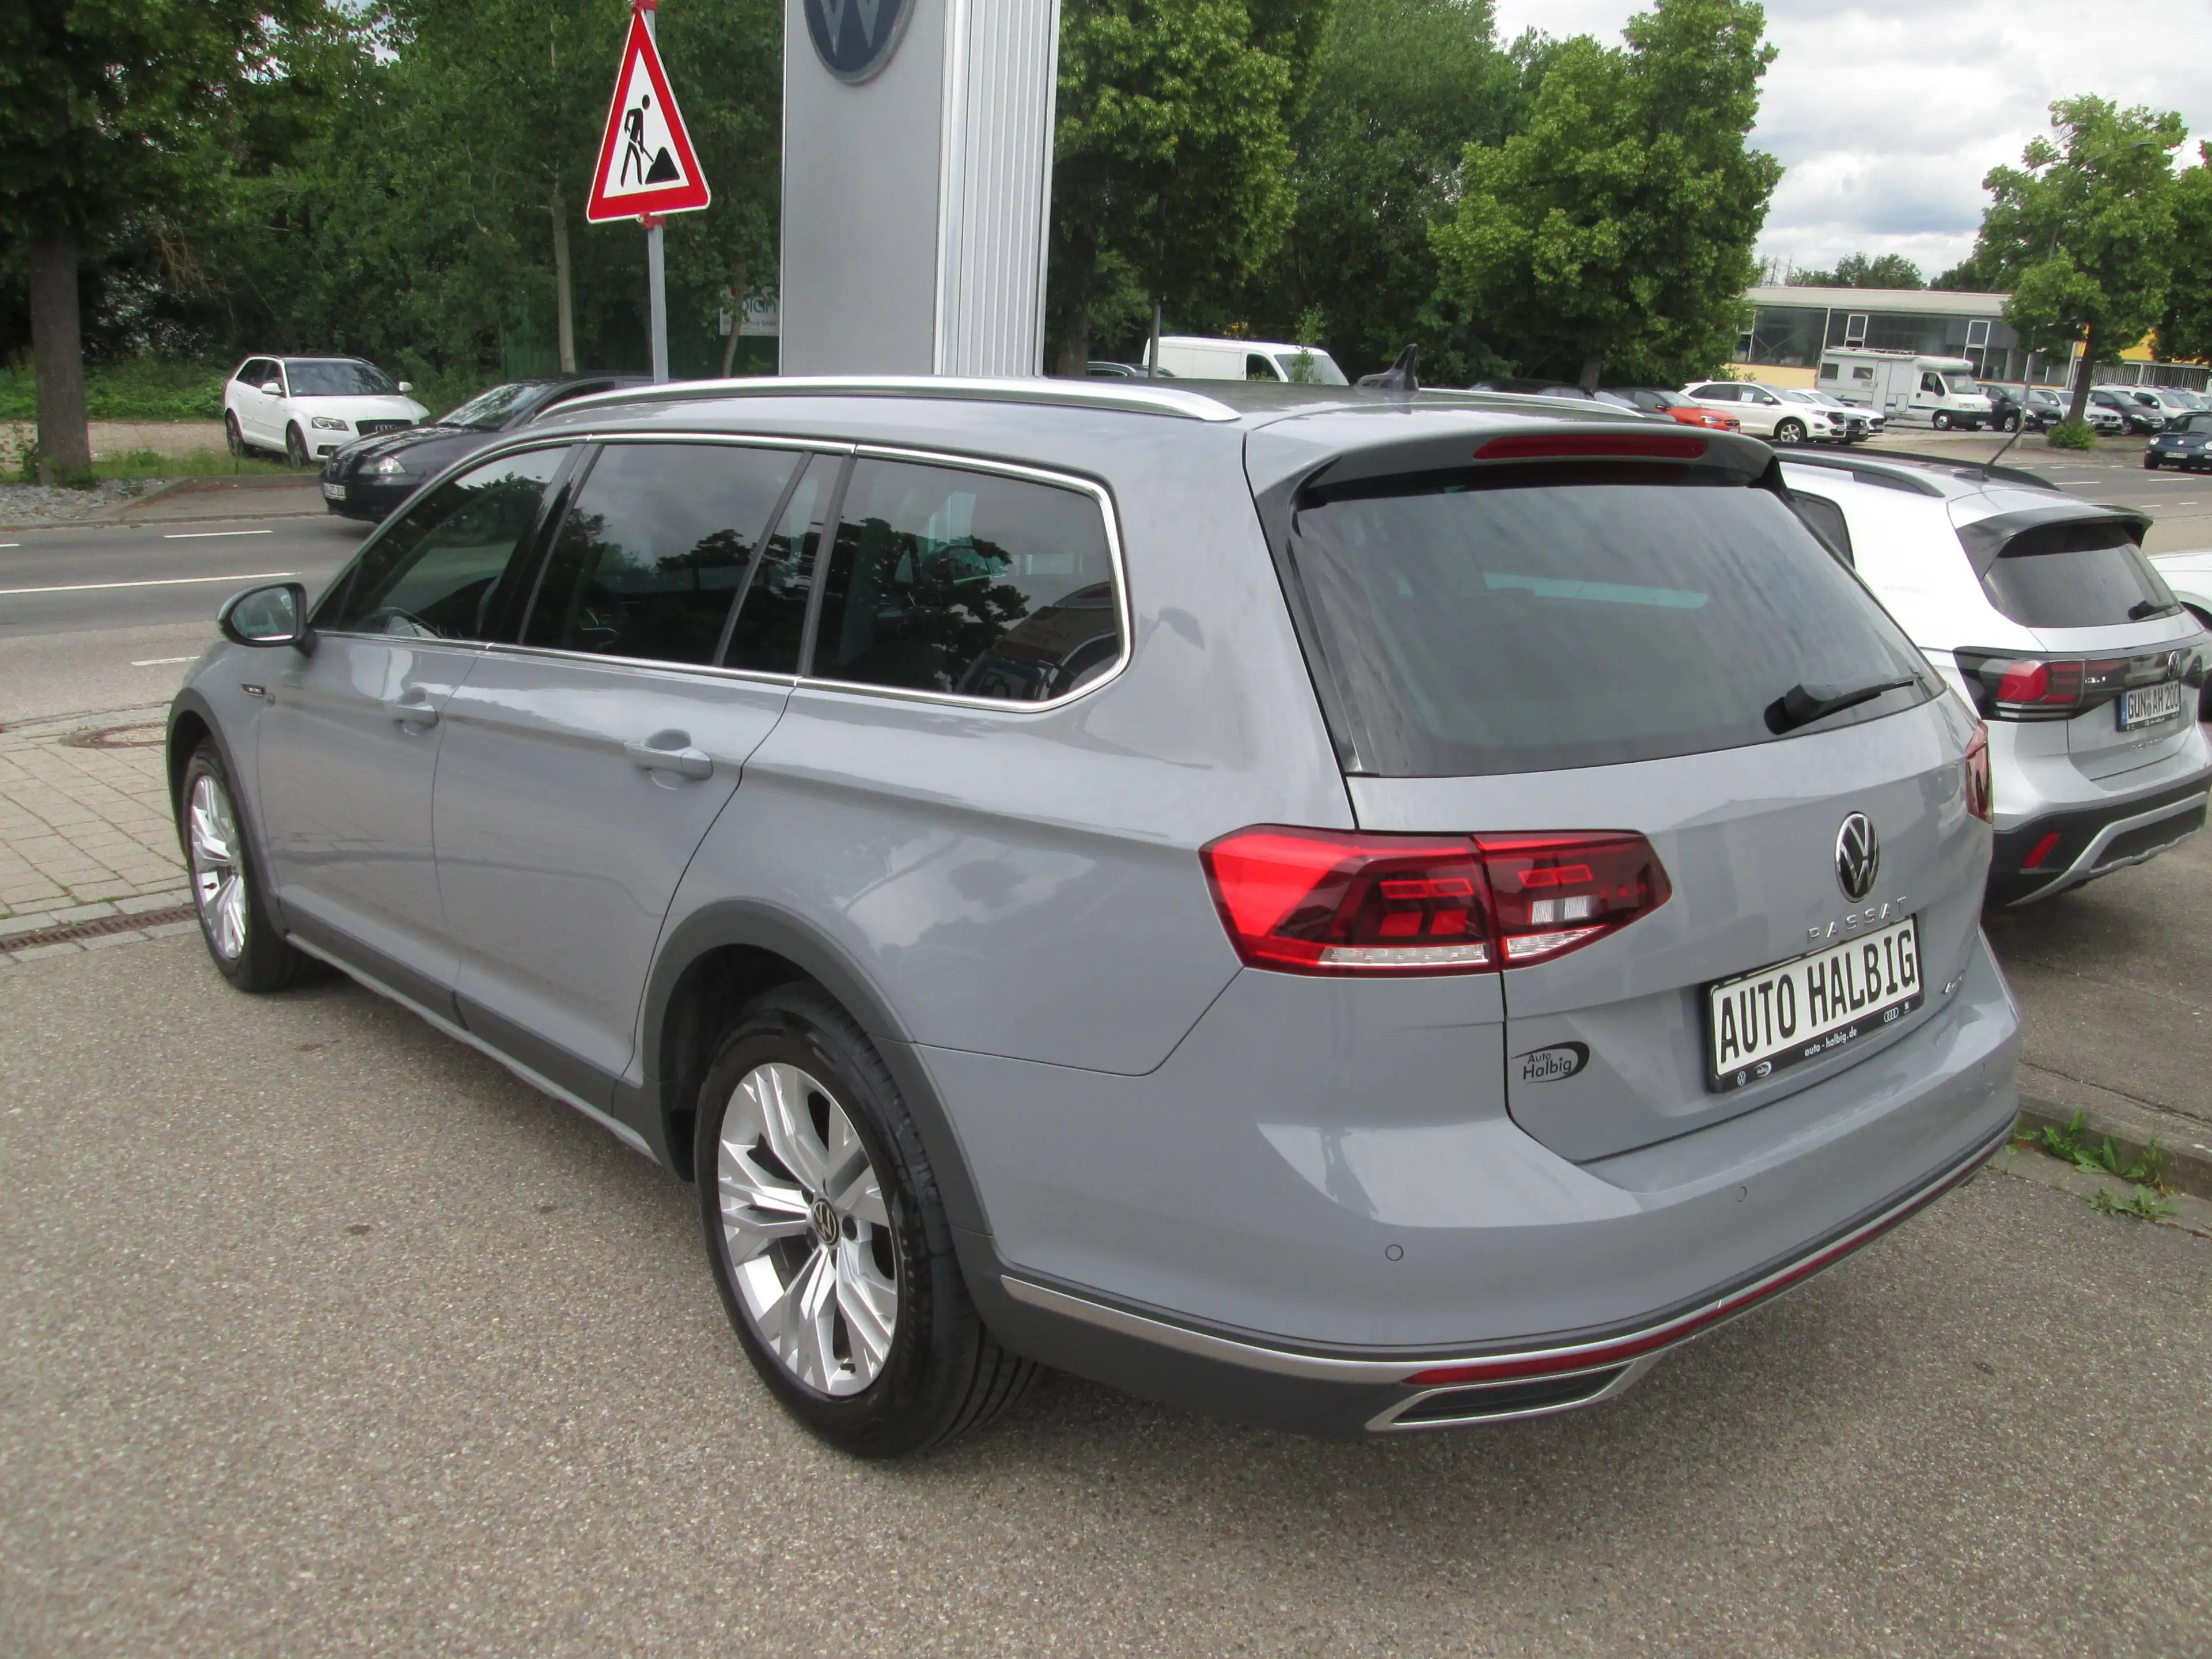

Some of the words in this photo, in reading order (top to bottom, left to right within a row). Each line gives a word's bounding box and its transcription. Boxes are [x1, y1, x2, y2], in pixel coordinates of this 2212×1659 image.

[2128, 692, 2146, 719] GUN
[2153, 687, 2164, 714] AH
[1808, 896, 1906, 944] PASSAT
[1720, 974, 1797, 1063] AUTO
[1806, 929, 1915, 1027] HALBIG
[1523, 1057, 1572, 1080] Halbig
[1528, 1052, 1551, 1063] Auto
